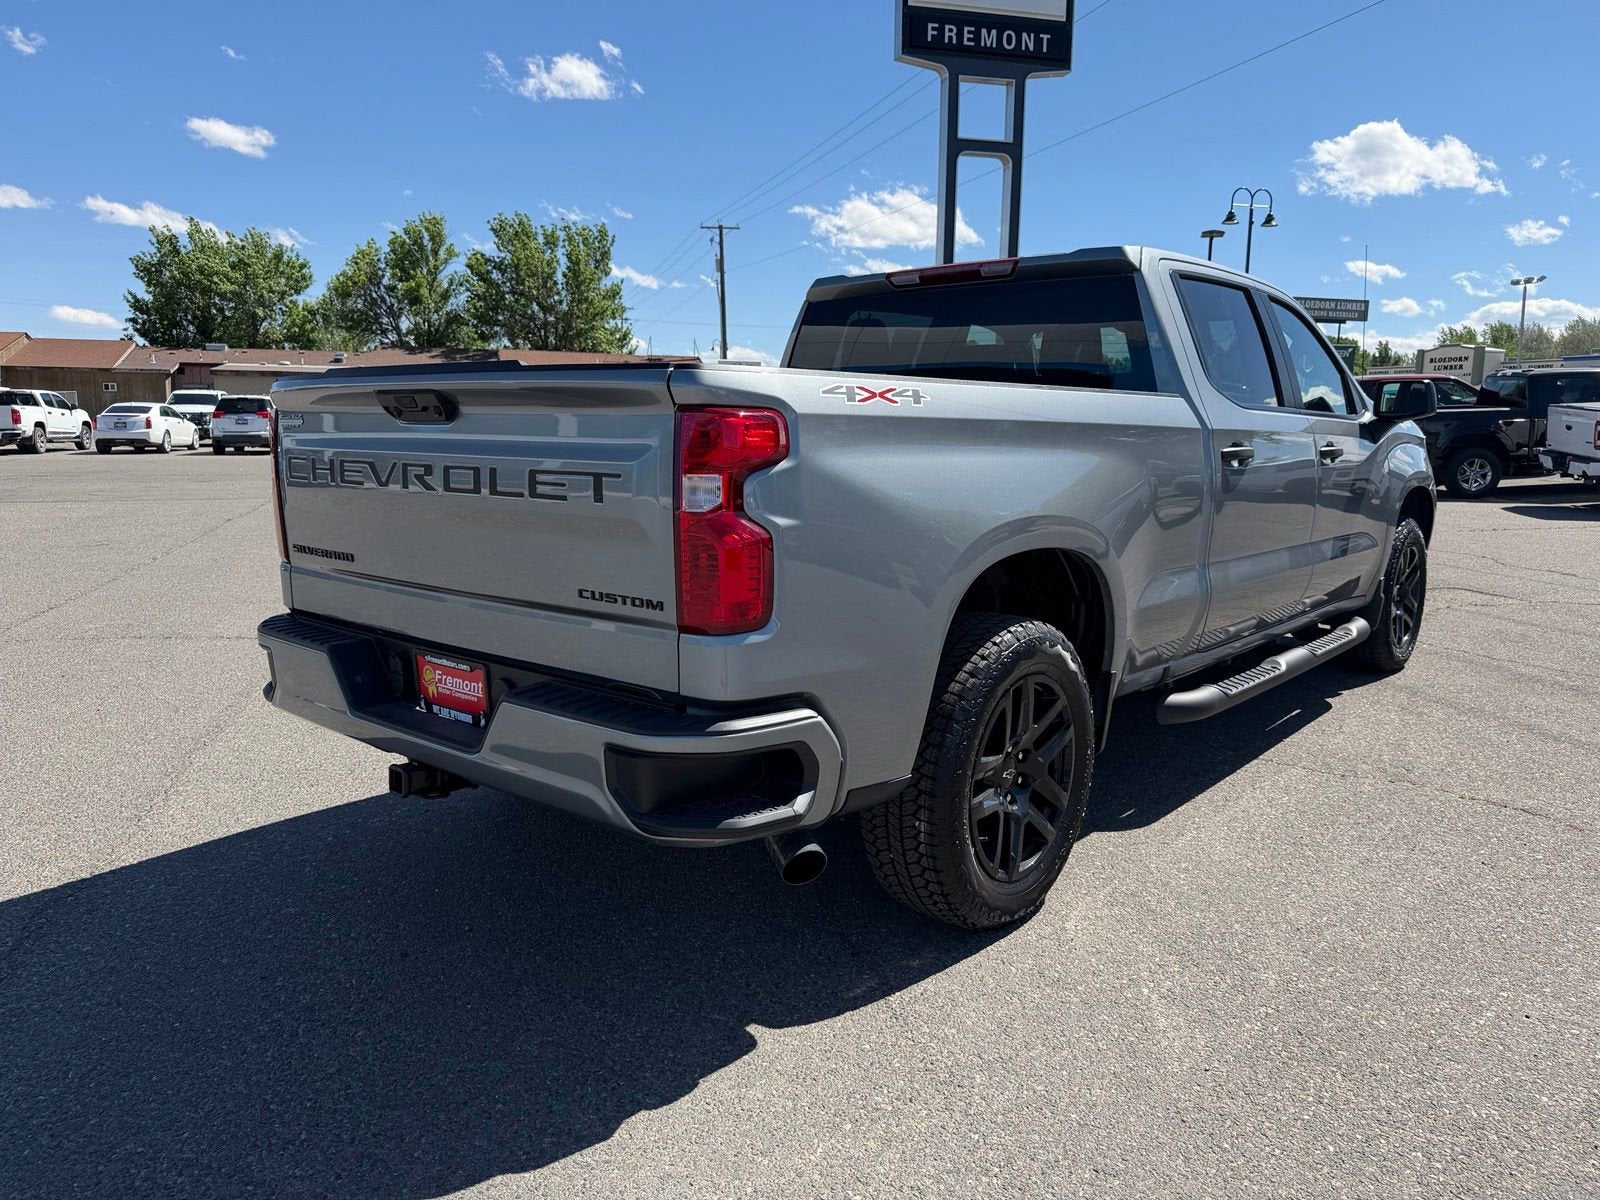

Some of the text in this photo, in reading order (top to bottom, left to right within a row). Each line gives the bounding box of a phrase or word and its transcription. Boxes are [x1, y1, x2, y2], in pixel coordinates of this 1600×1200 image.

[927, 22, 1051, 53] FREMONT
[1429, 355, 1470, 364] BLOEDORN
[1433, 364, 1464, 372] LUMBER
[287, 454, 622, 505] CHEVROLET
[293, 544, 355, 562] SILVERADO
[577, 588, 664, 611] CUSTOM
[435, 670, 483, 695] Fremont
[438, 687, 478, 702] Motor Companies
